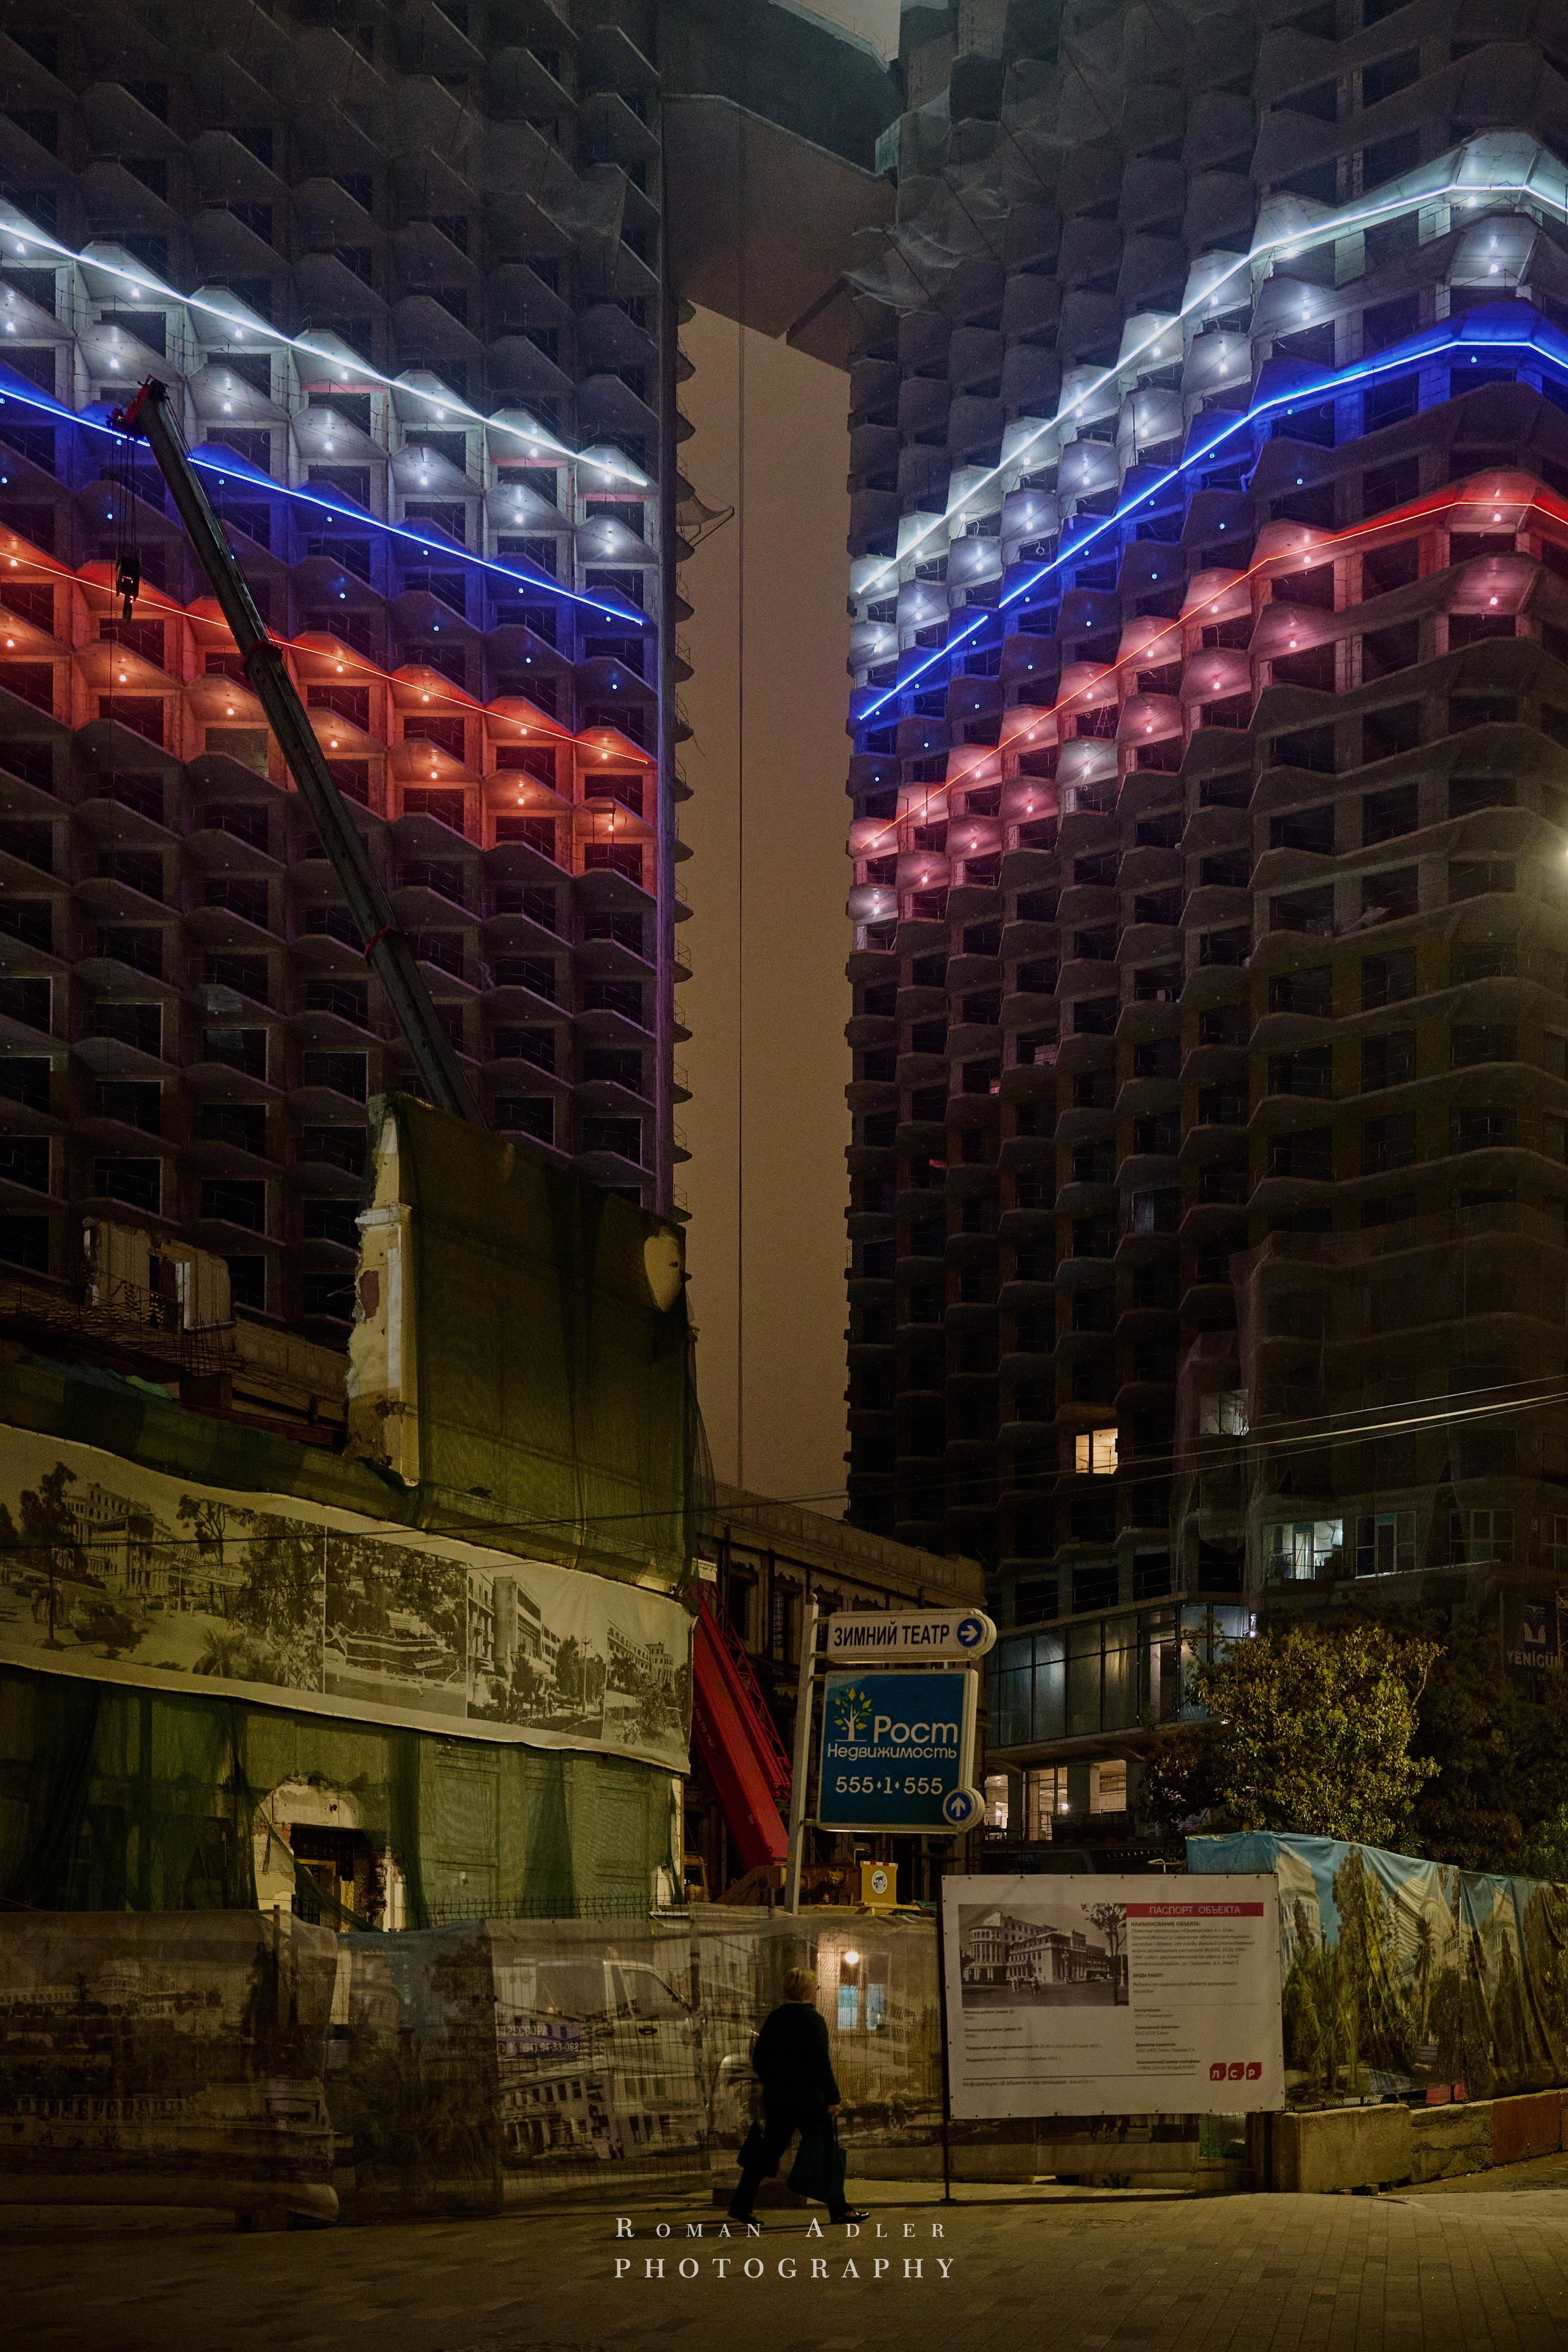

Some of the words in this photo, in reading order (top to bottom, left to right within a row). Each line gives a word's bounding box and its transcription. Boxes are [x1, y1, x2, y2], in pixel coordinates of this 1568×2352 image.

[834, 1621, 897, 1646] ЗИМНИЙ
[902, 1624, 950, 1645] ТЕАТР
[873, 1715, 959, 1744] Рост
[827, 1743, 957, 1762] Недвижимость
[1149, 1905, 1193, 1915] ПАСПОРТ
[1198, 1905, 1241, 1914] ОБЪЕКТА
